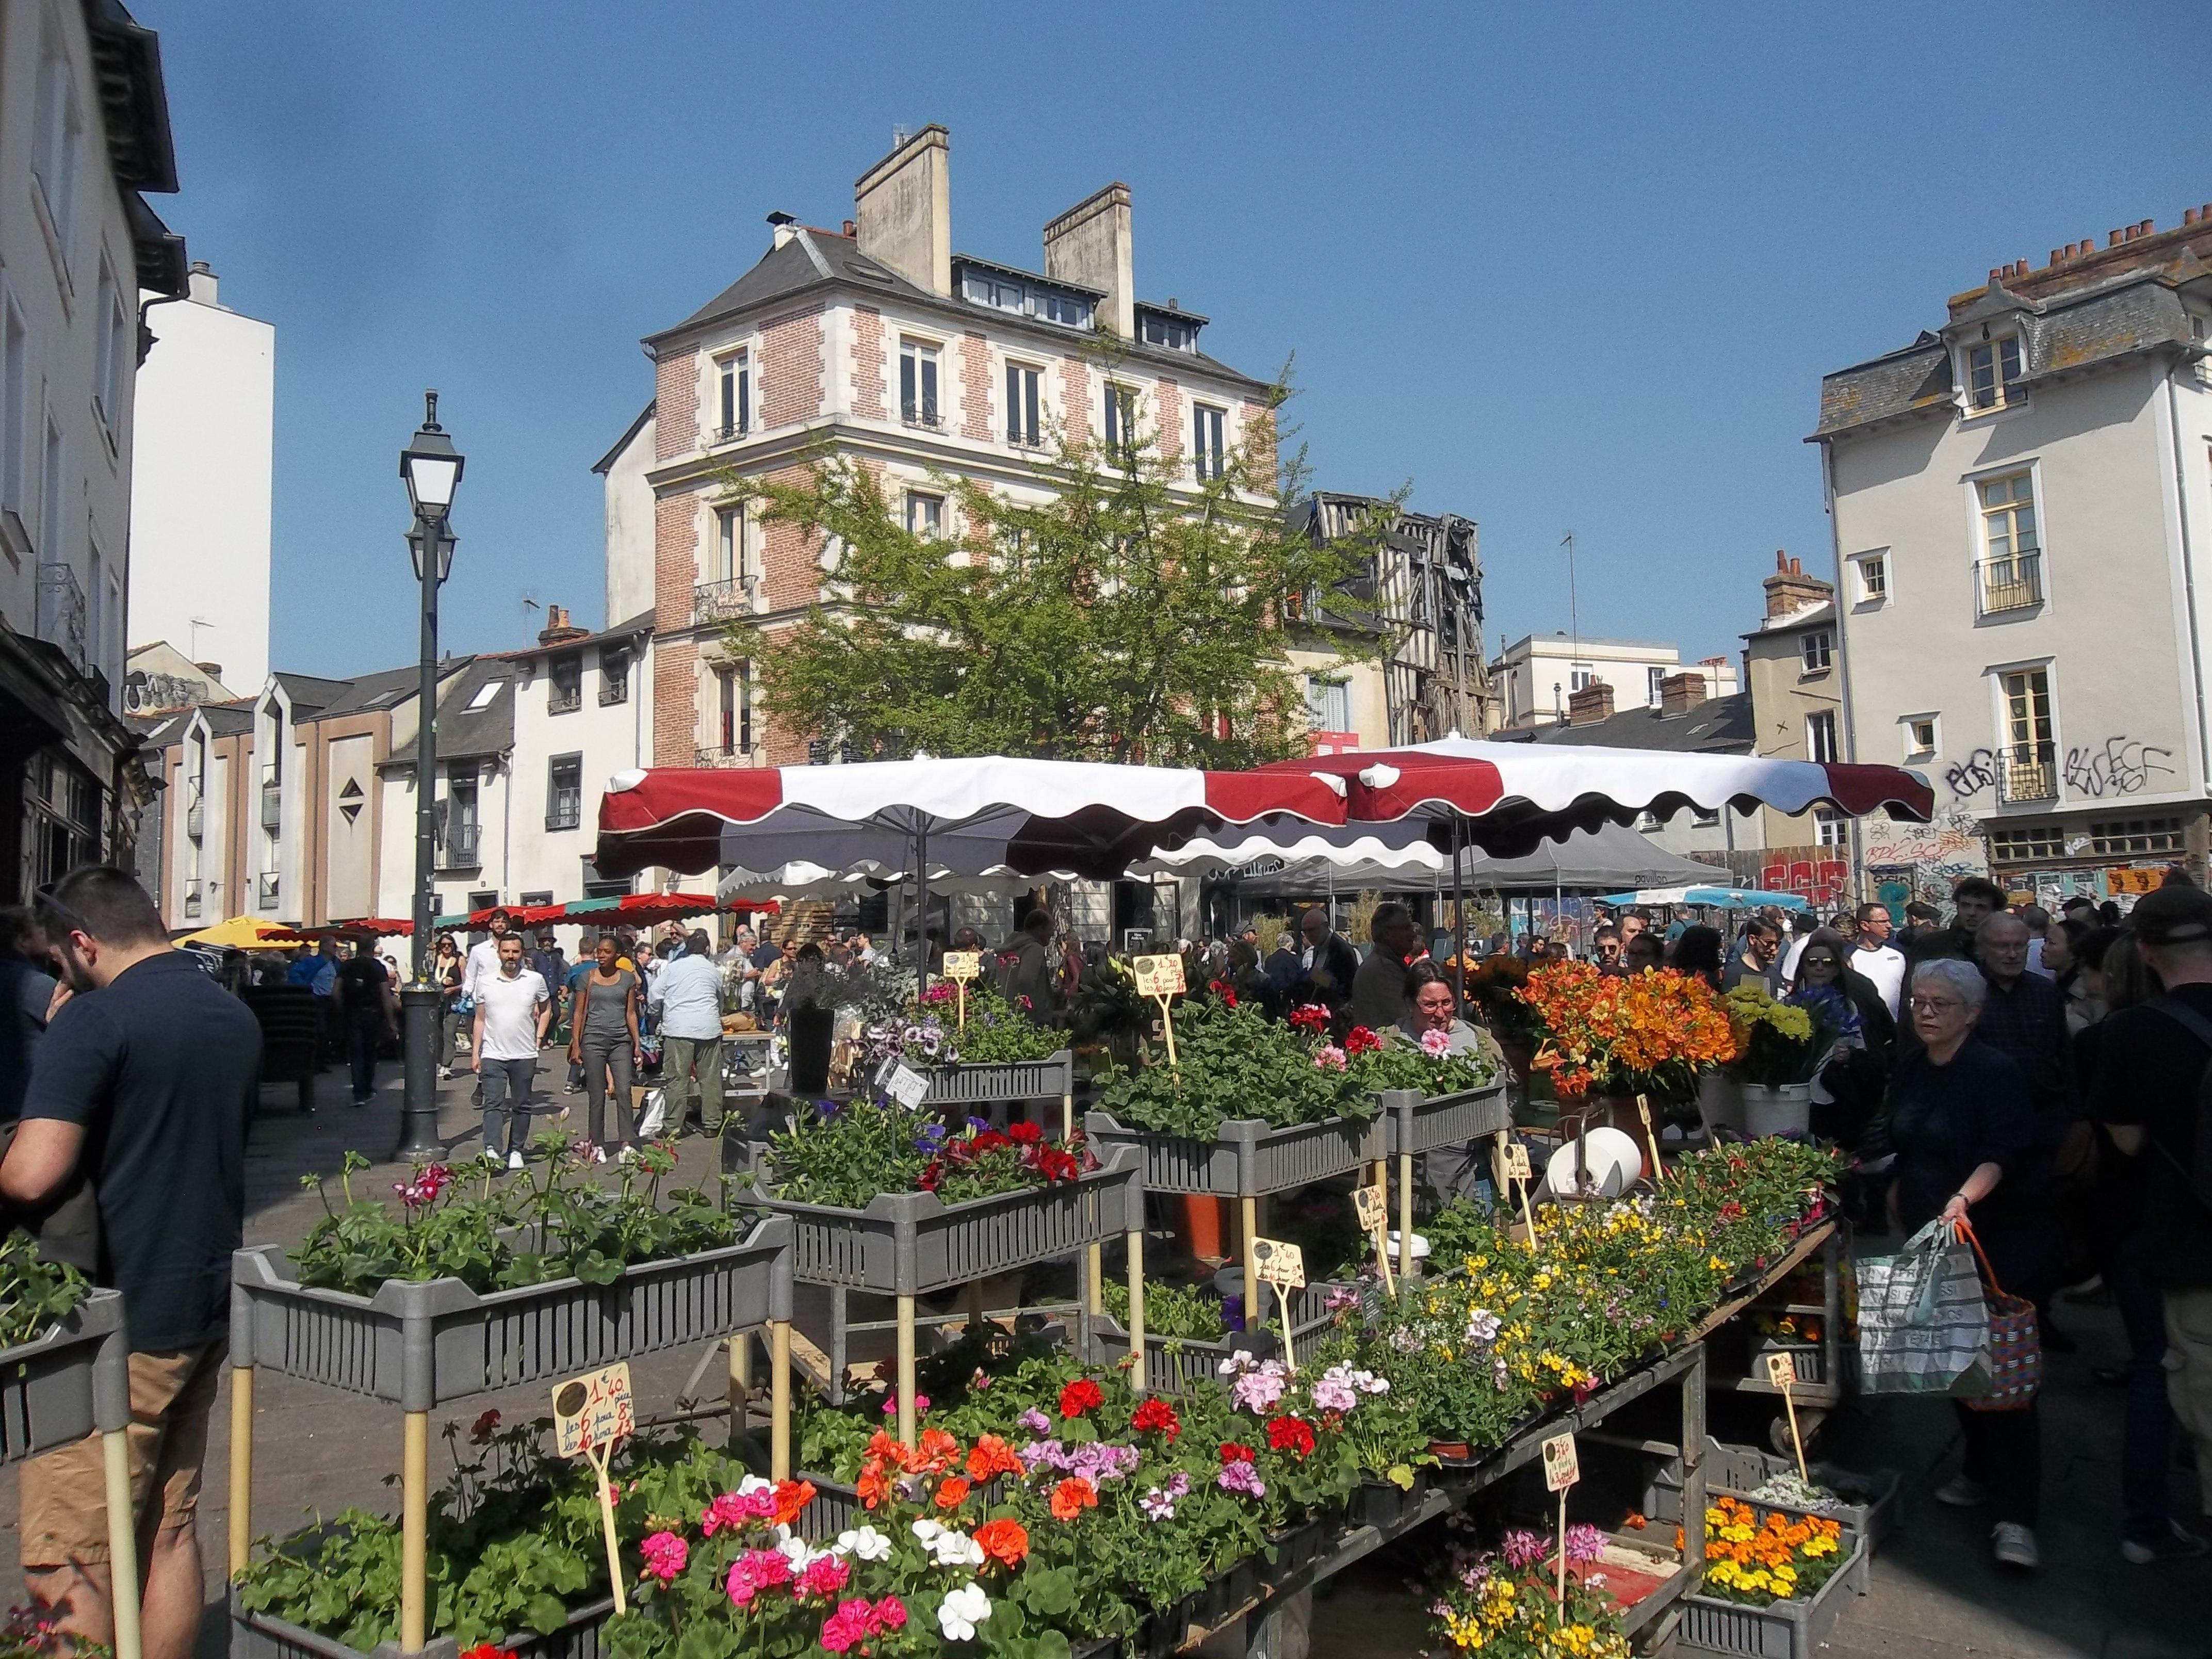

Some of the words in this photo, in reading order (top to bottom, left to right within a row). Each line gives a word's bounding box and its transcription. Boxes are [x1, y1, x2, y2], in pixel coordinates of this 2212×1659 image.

[1634, 871, 1667, 886] pavillon
[1153, 971, 1159, 984] 6
[562, 1419, 580, 1438] les
[581, 1407, 591, 1433] 6
[593, 1411, 615, 1426] pour
